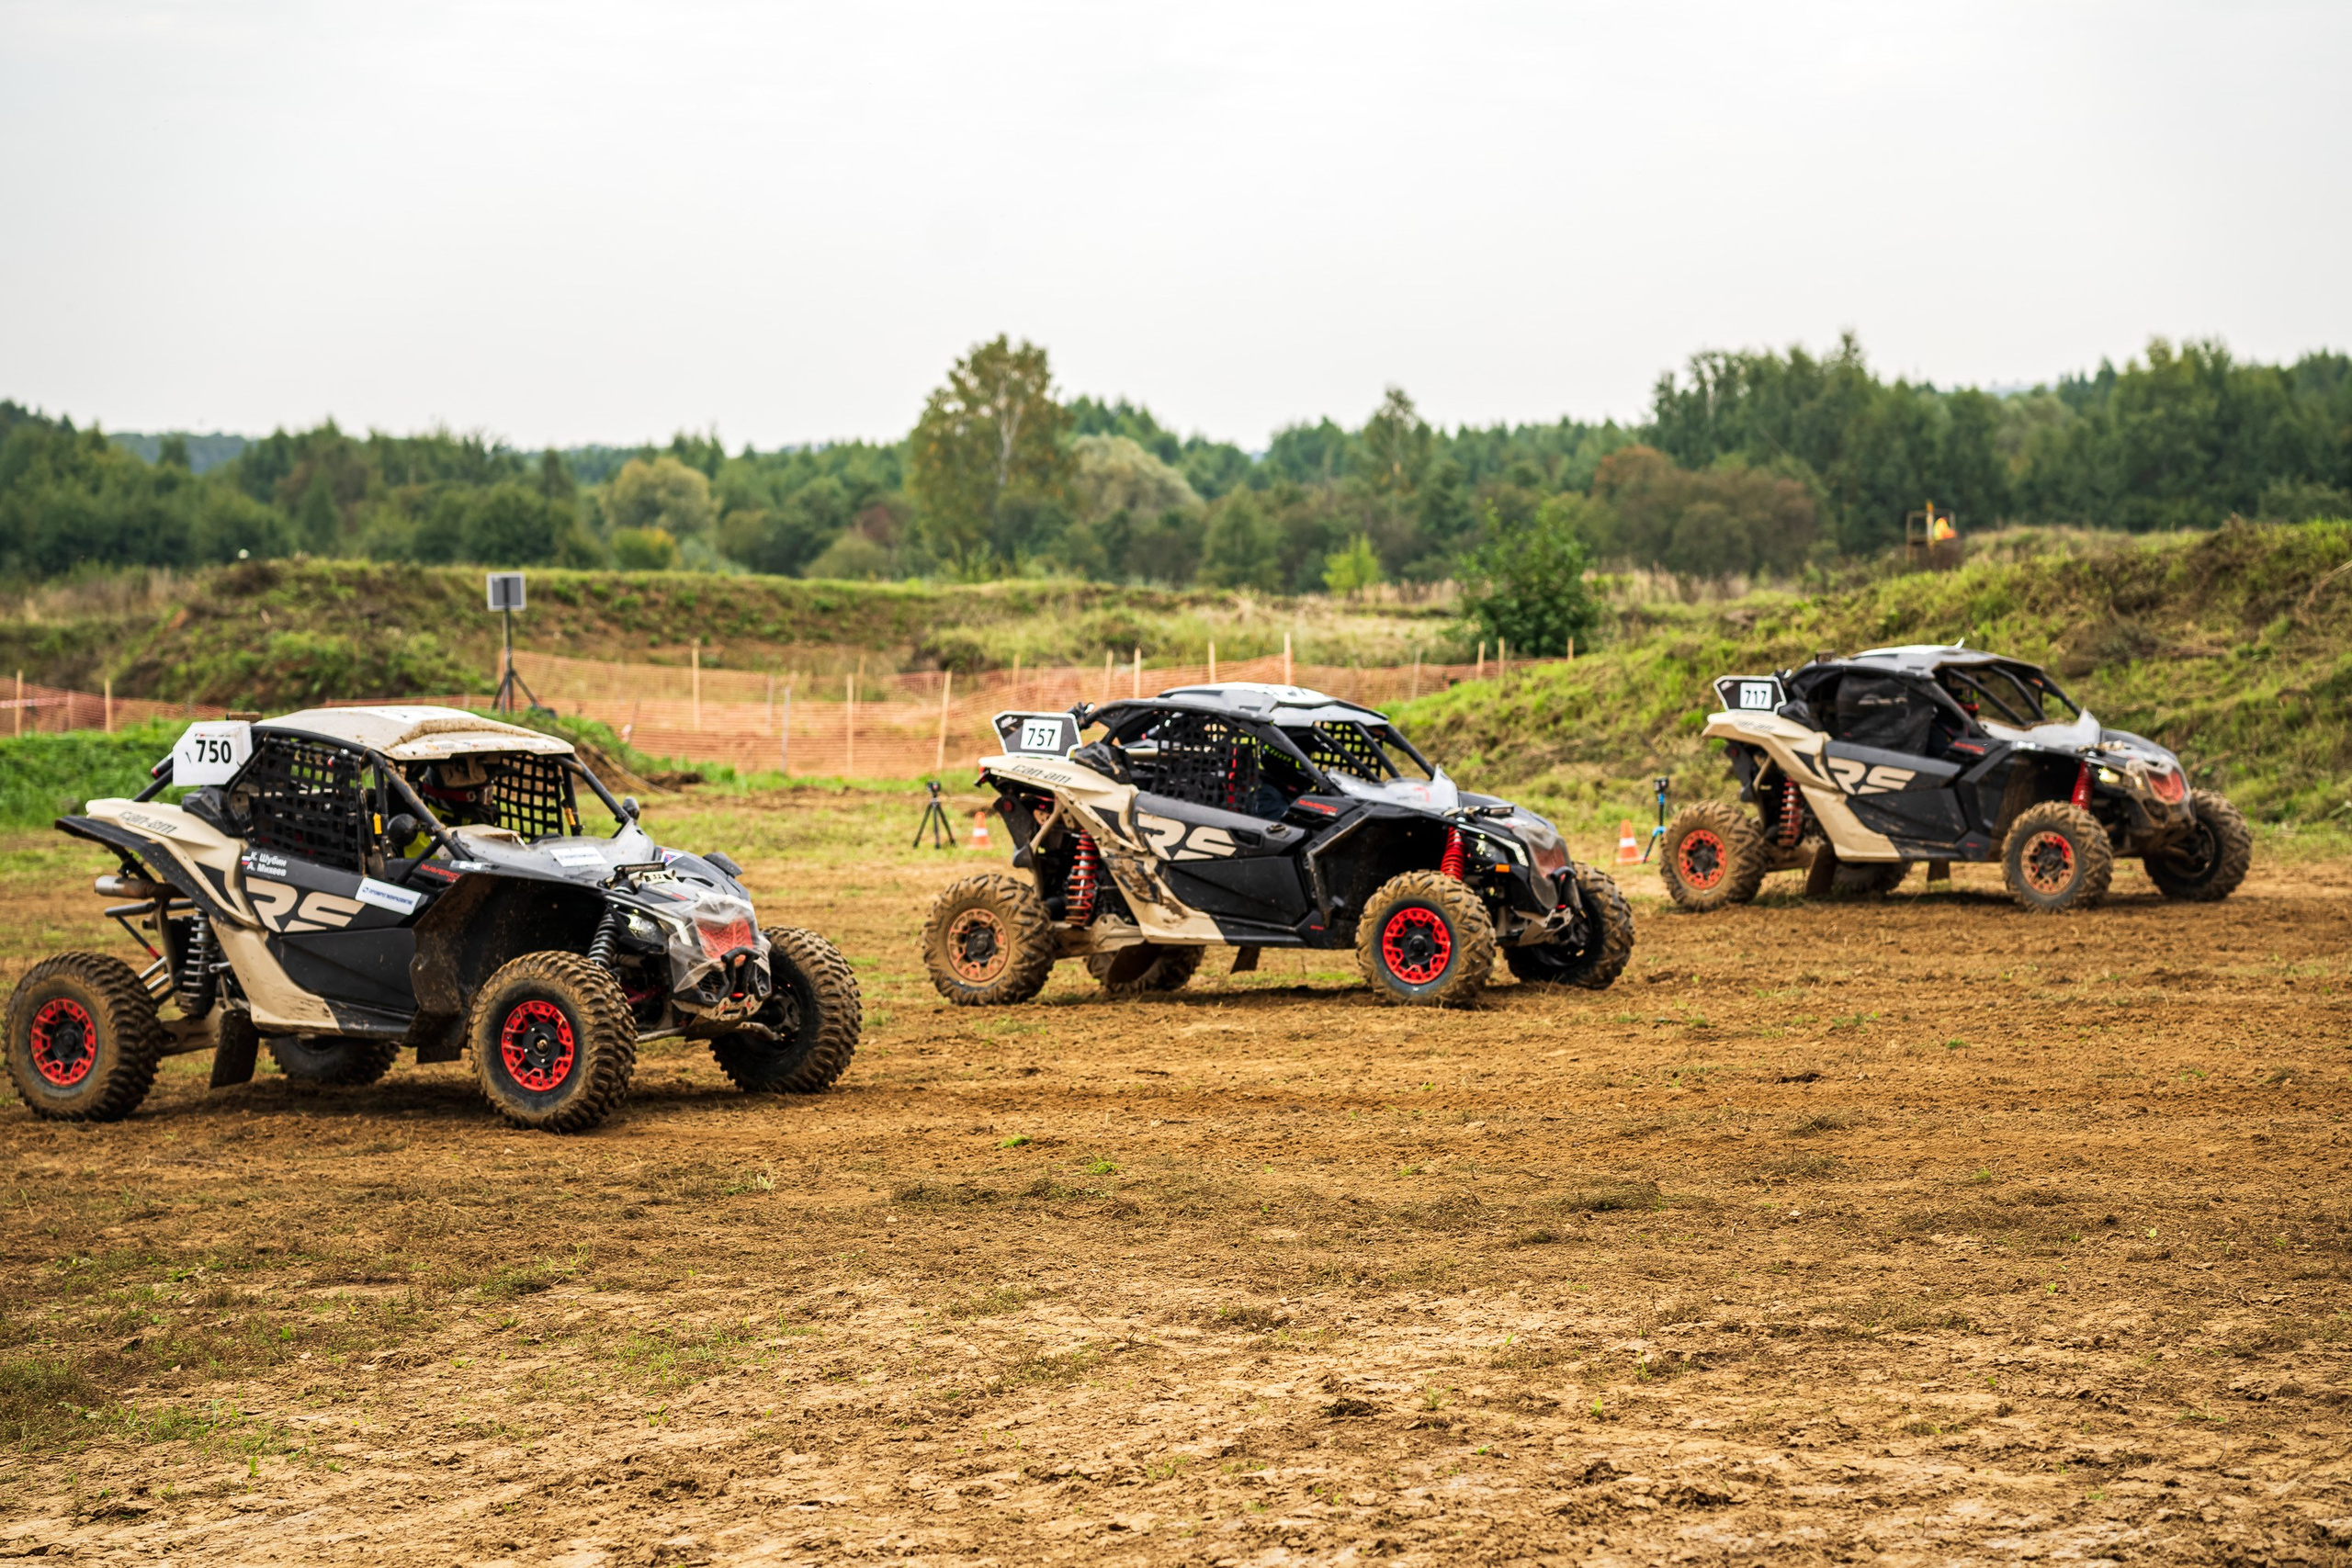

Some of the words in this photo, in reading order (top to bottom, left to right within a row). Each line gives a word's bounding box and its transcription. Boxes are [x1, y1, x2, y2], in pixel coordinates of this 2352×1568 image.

[1745, 690, 1767, 705] 717
[195, 739, 232, 764] 750
[1027, 728, 1057, 747] 757
[1827, 756, 1917, 796] RS
[1136, 812, 1238, 862] RS
[245, 875, 367, 933] RS
